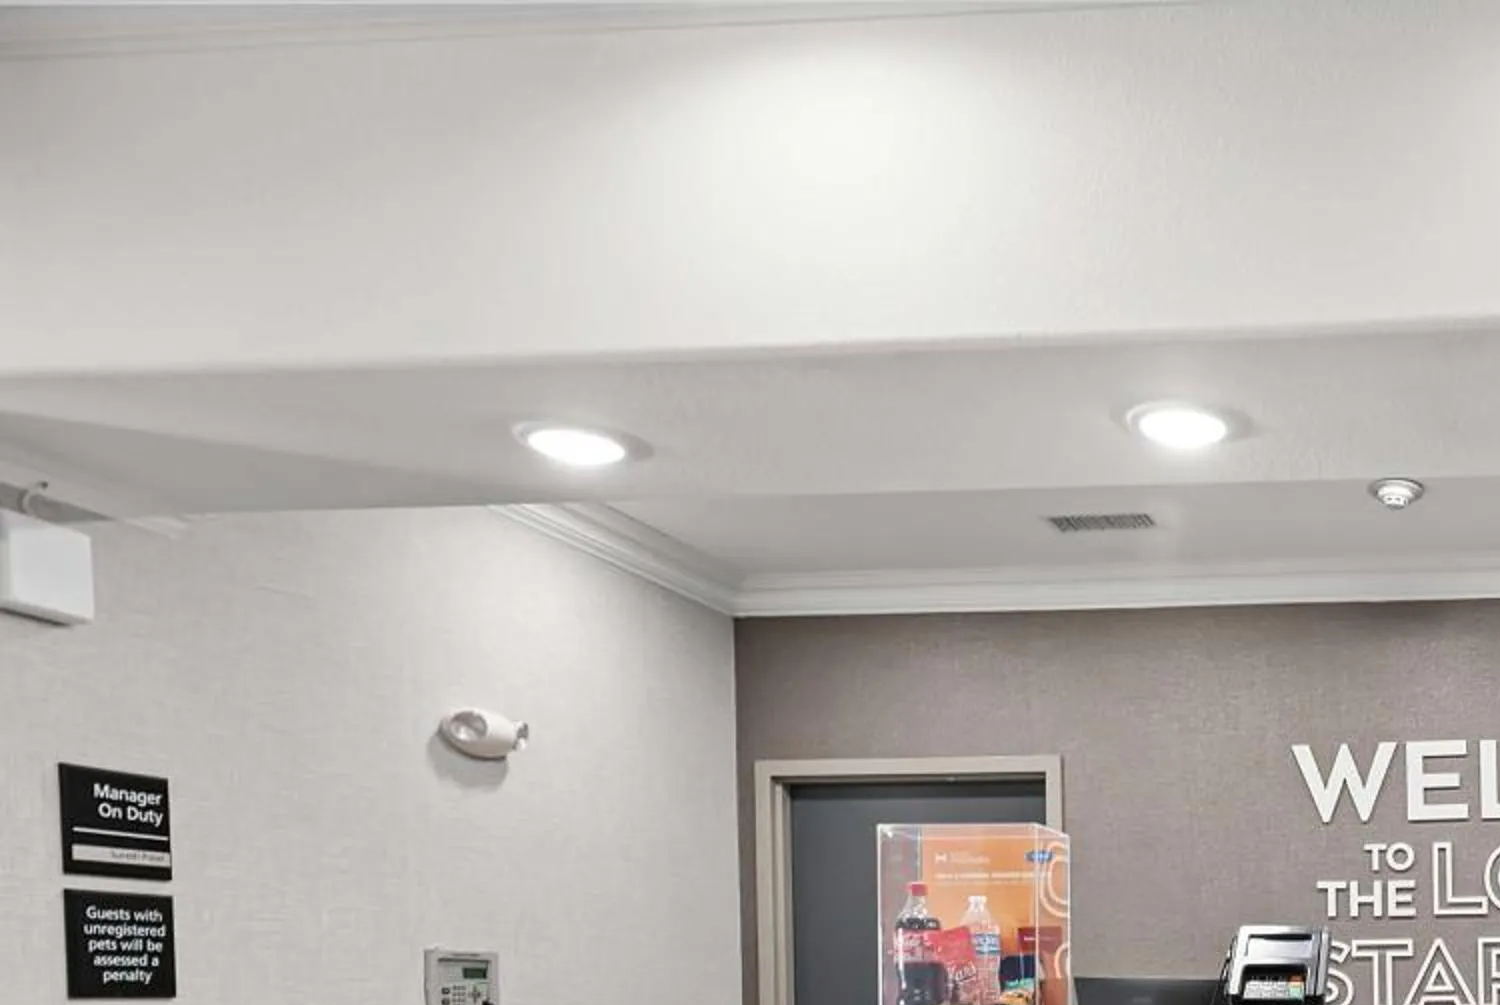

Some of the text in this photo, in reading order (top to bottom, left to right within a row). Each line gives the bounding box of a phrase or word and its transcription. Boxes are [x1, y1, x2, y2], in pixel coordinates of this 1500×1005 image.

[93, 783, 162, 807] Manager
[98, 802, 163, 828] On Duty
[1364, 842, 1415, 872] TO
[1317, 879, 1417, 918] THE
[86, 905, 163, 922] Guests with
[83, 923, 166, 939] unregistered
[88, 939, 163, 952] pets will be
[93, 954, 160, 967] assessed a
[103, 968, 153, 984] penalty
